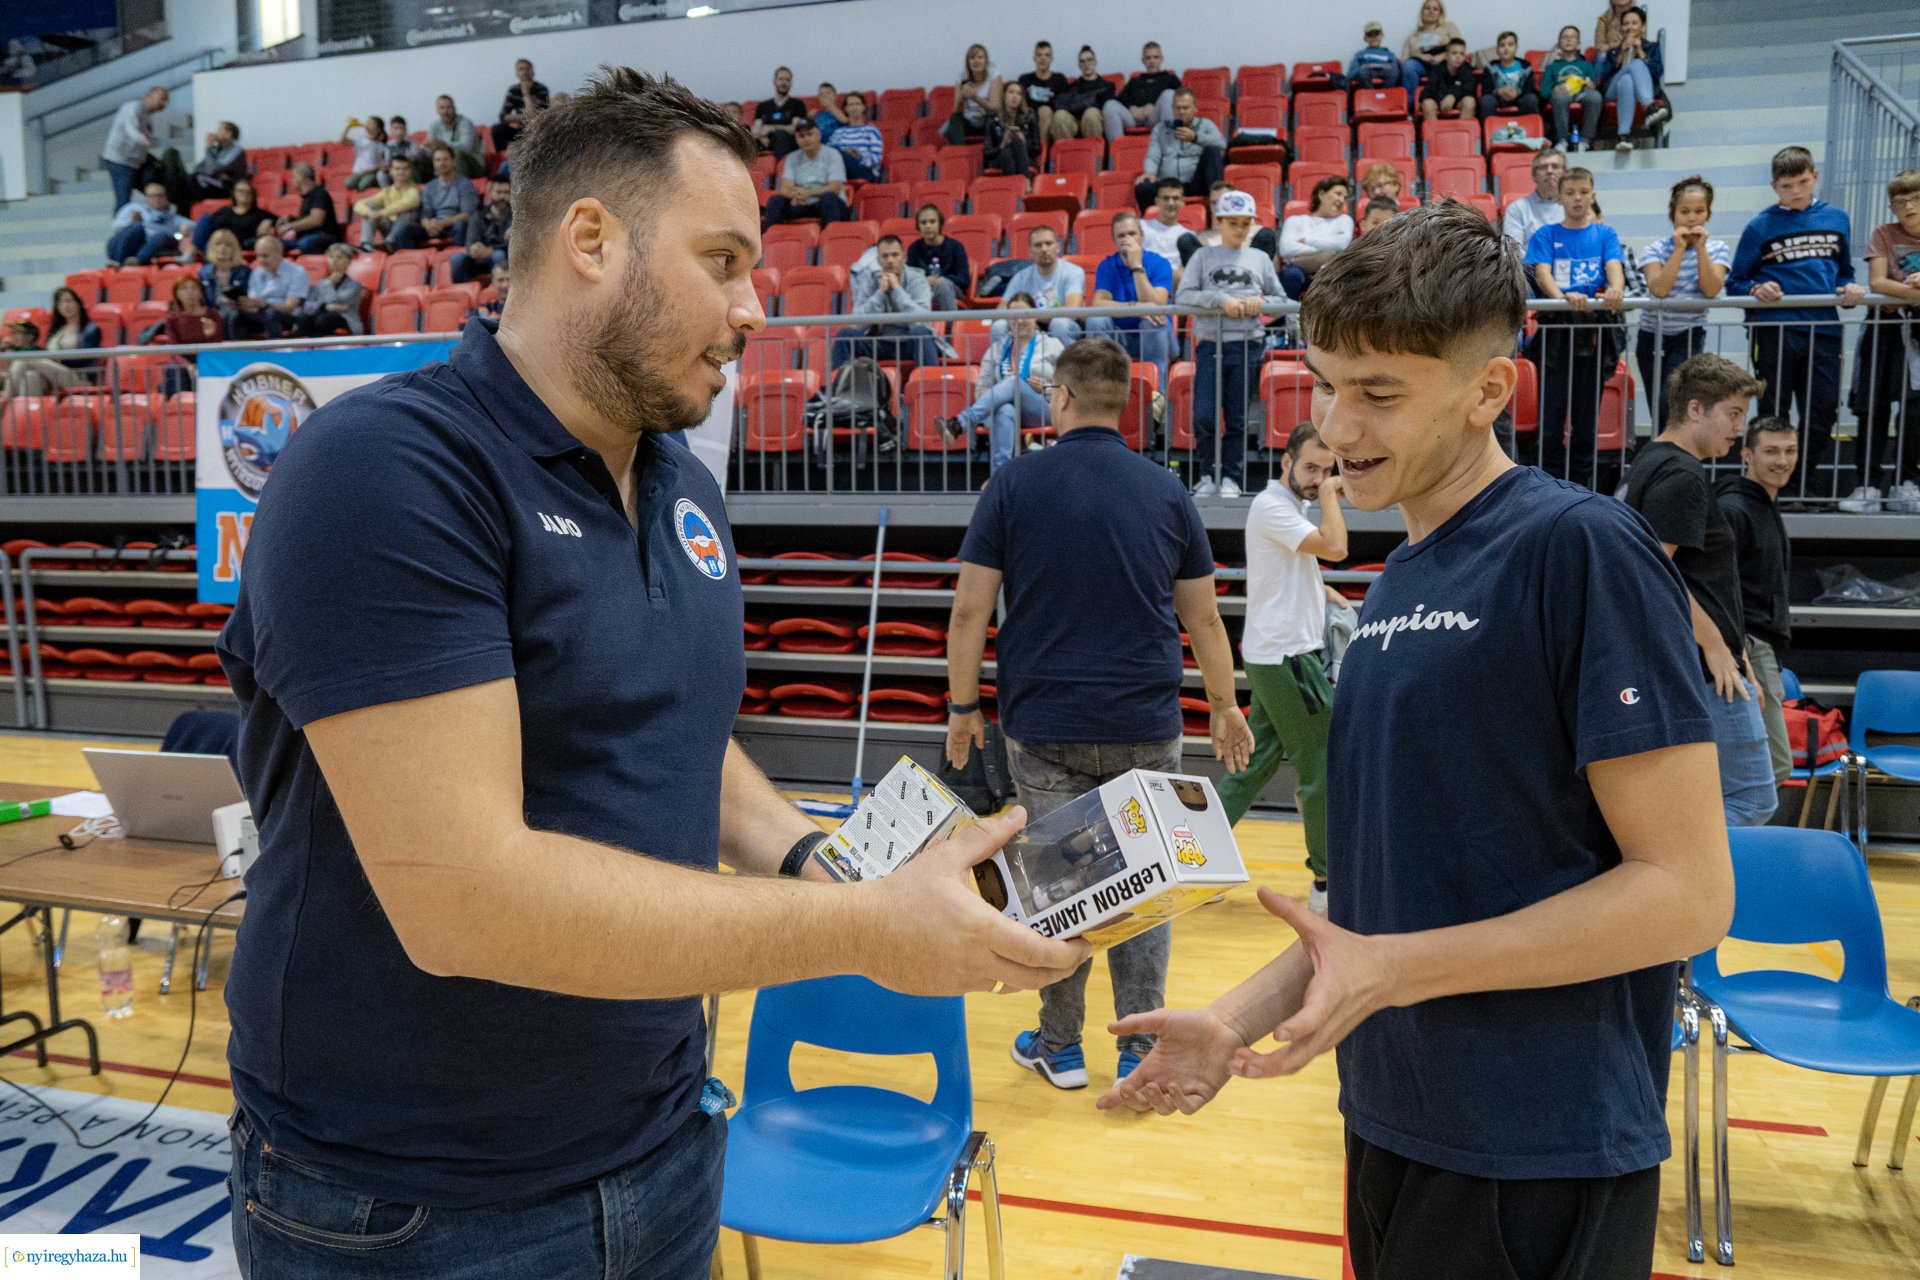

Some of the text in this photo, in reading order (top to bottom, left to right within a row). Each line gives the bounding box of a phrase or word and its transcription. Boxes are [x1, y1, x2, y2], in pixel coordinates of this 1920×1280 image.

[1126, 796, 1148, 834] POP!
[1176, 838, 1208, 868] POP!
[1091, 861, 1168, 914] LeBRON
[80, 1113, 118, 1132] A
